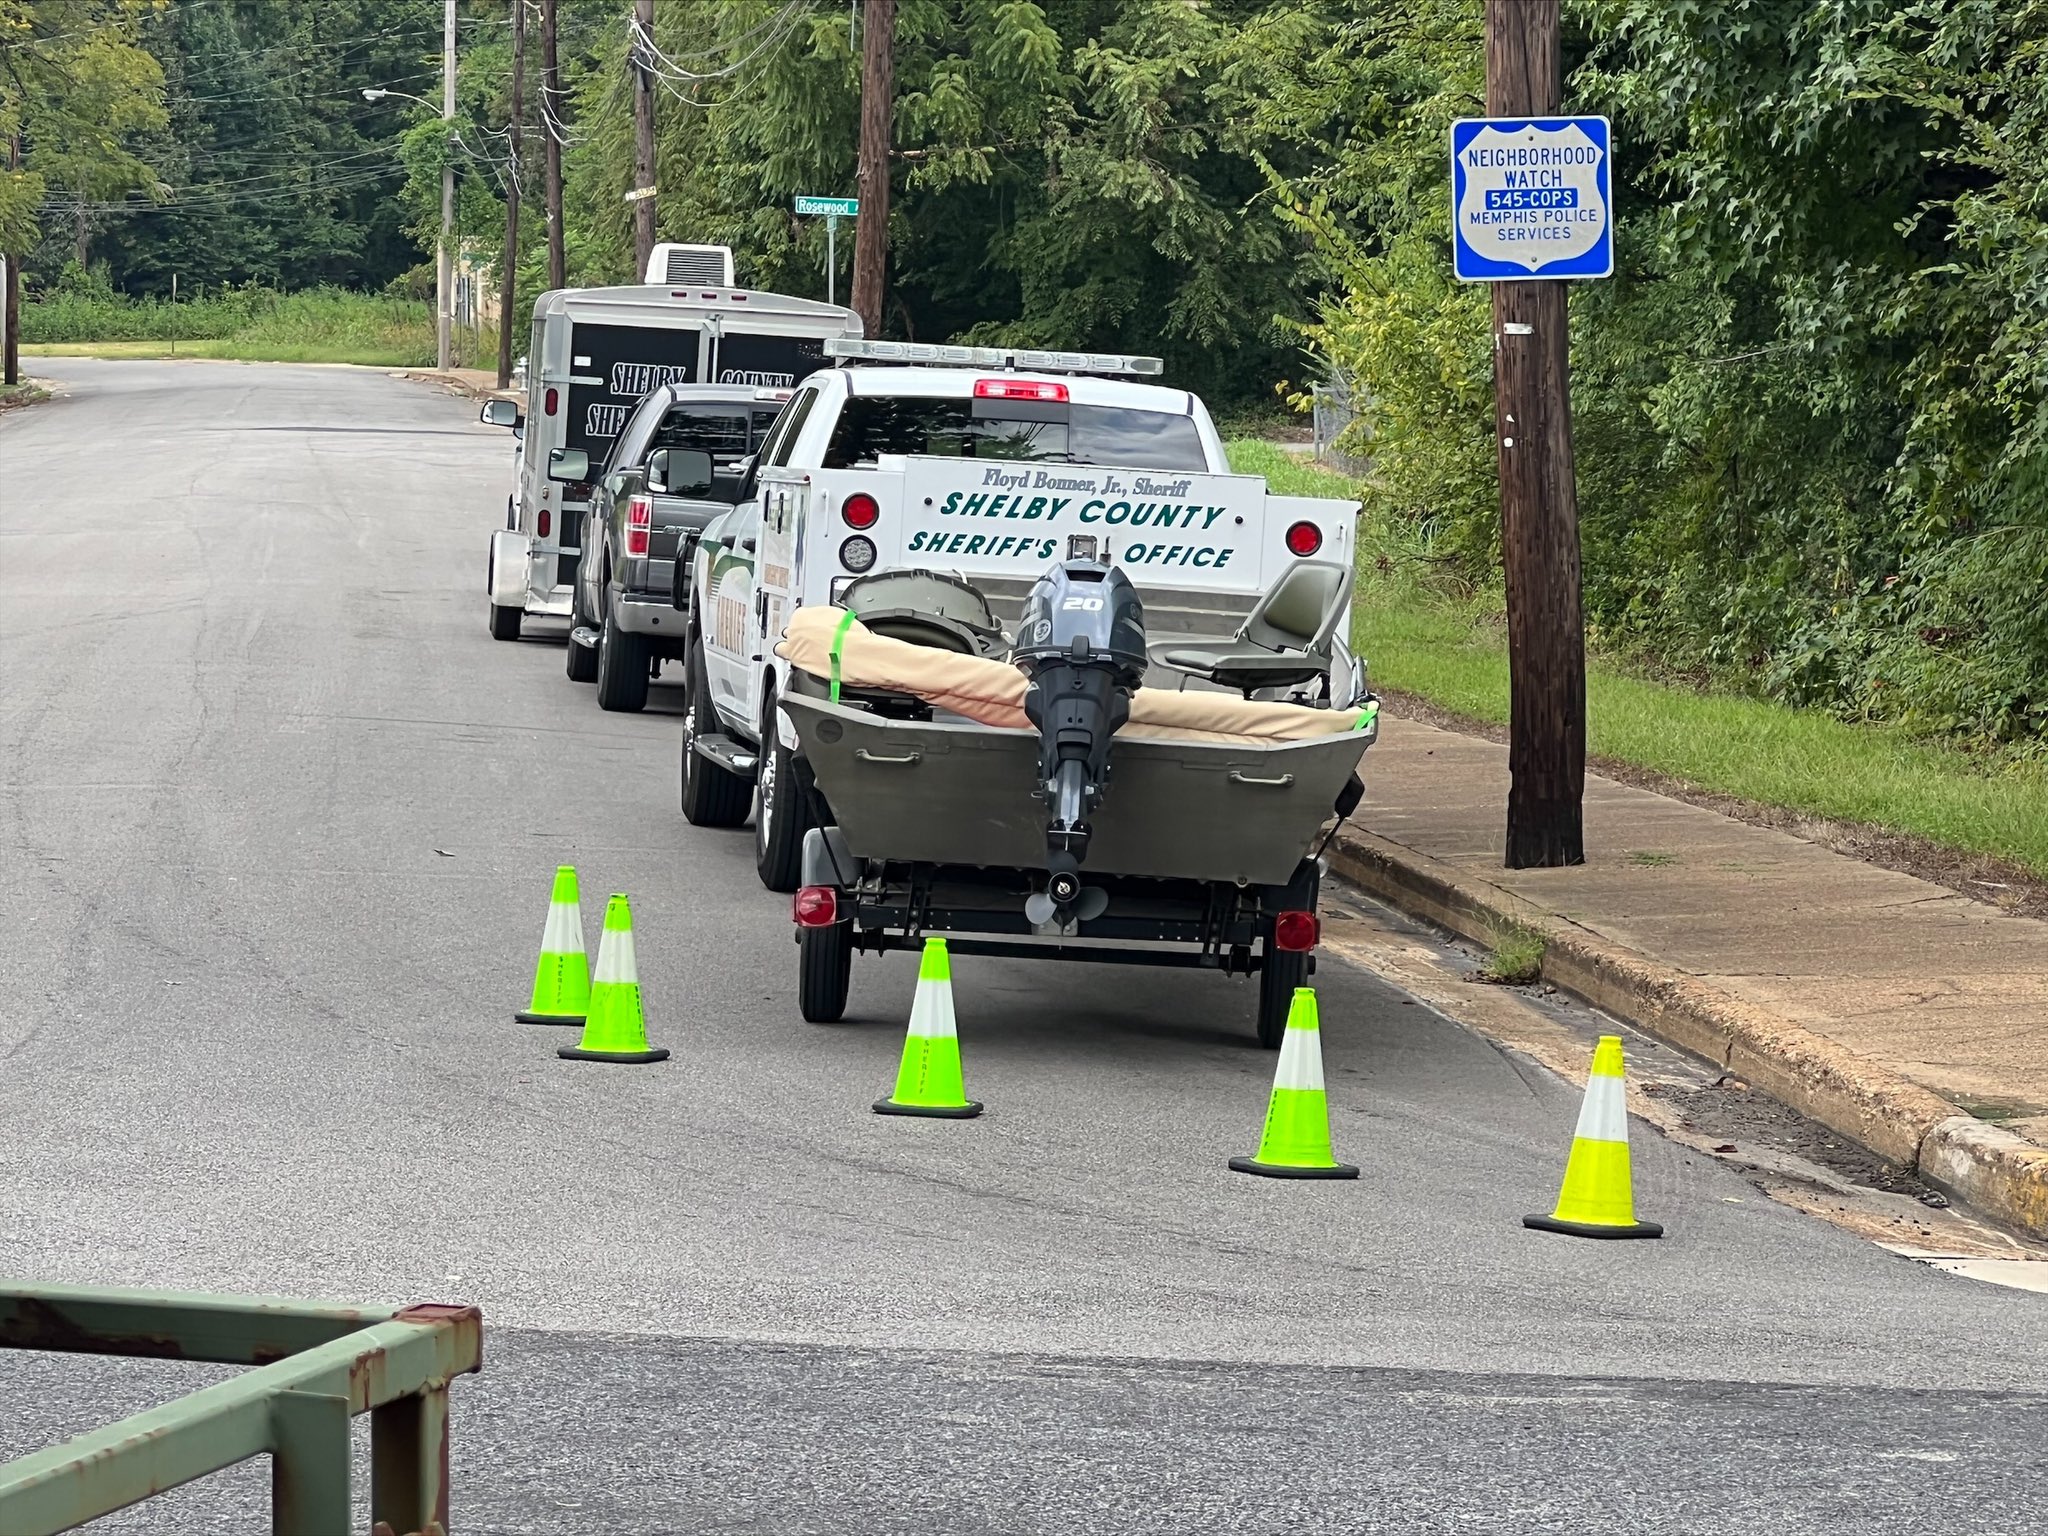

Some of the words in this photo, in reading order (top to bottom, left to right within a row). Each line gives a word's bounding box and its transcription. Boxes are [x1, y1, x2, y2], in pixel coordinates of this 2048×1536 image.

[1468, 146, 1597, 167] NEIGHBORHOOD
[1504, 169, 1562, 188] WATCH
[798, 199, 849, 213] Rosewood
[1491, 190, 1573, 208] 545-COPS
[1470, 210, 1538, 225] MEMPHIS
[1544, 209, 1598, 223] POLICE
[1497, 226, 1572, 241] SERVICES
[981, 468, 1031, 492] Floyd
[1032, 470, 1097, 496] Bonner,
[1100, 475, 1128, 498] Jr.,
[1132, 477, 1192, 498] Sheriff
[940, 491, 1072, 521] SHELBY
[1079, 499, 1227, 530] COUNTY
[908, 531, 1058, 560] SHERIFF'S
[1124, 543, 1235, 568] OFFICE
[1062, 597, 1104, 612] 20
